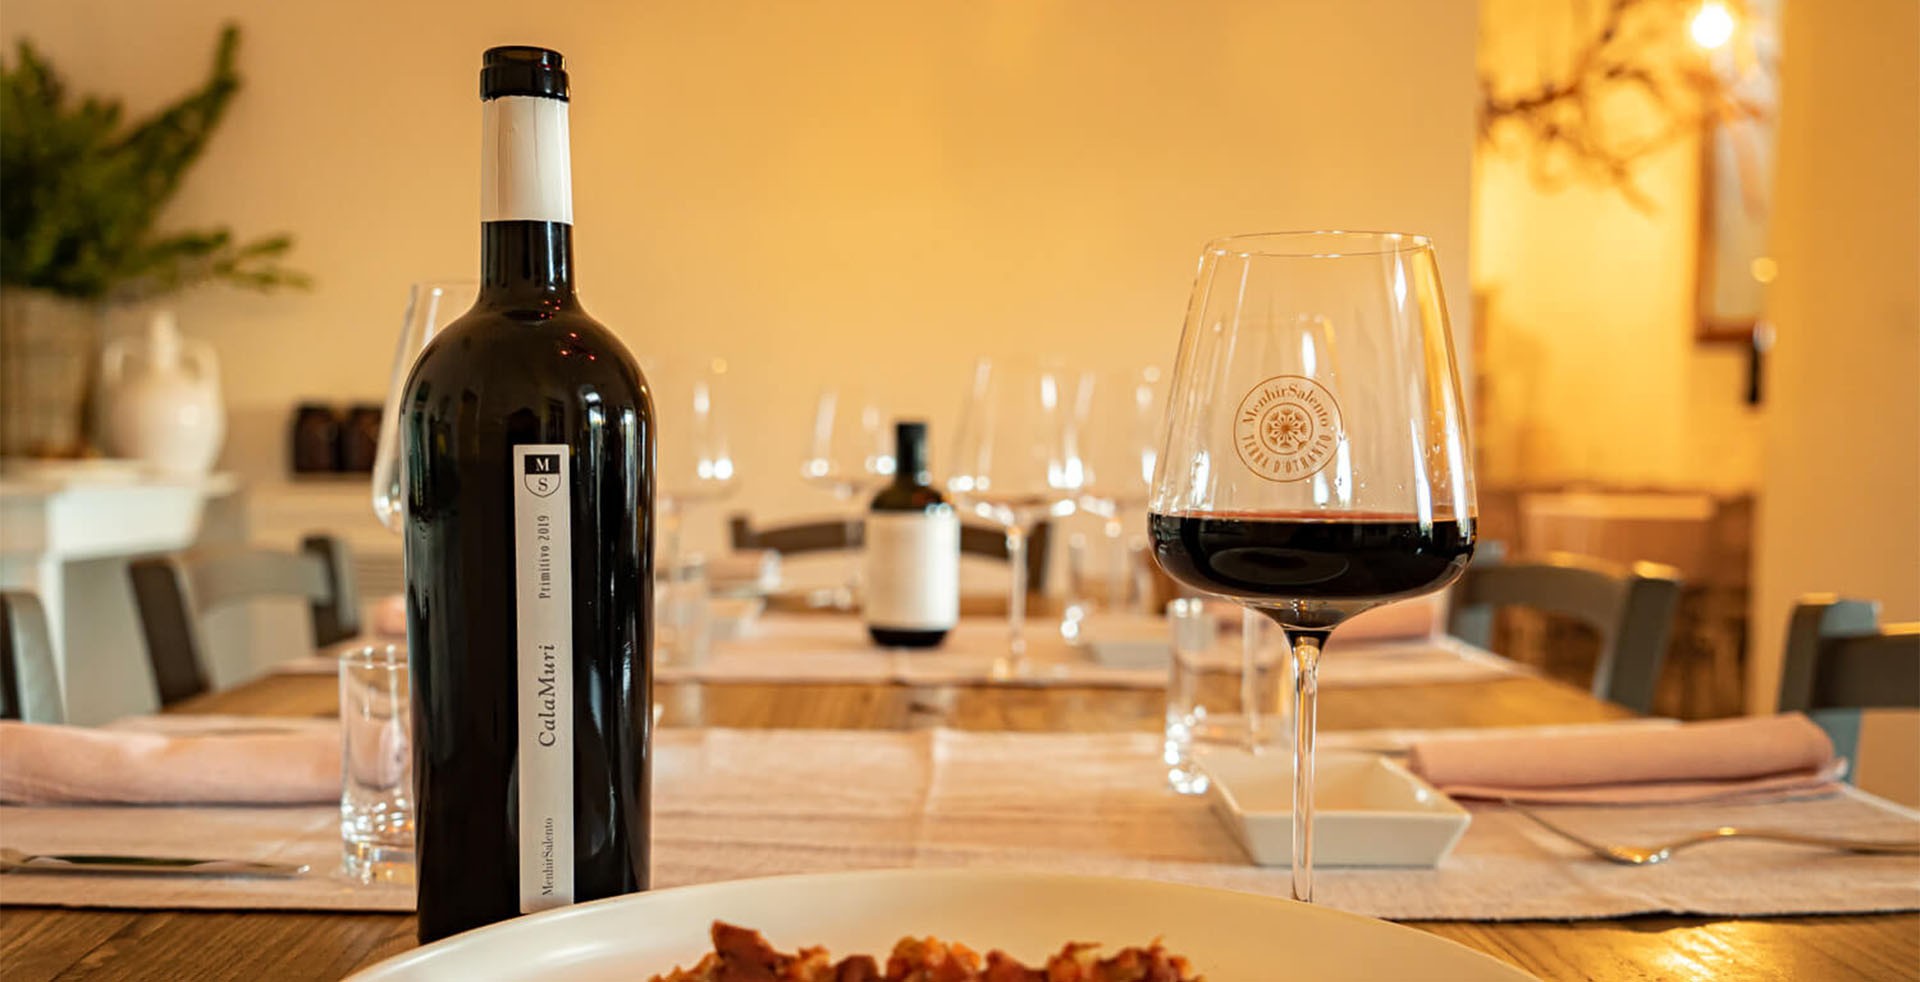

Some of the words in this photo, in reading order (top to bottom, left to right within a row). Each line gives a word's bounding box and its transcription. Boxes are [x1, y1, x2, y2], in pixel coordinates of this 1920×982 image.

[535, 457, 550, 472] M
[538, 477, 549, 492] S
[537, 515, 550, 541] 2019
[538, 545, 551, 600] Primitivo
[538, 643, 556, 748] CalaMuri
[542, 817, 553, 896] MenhirSalento
